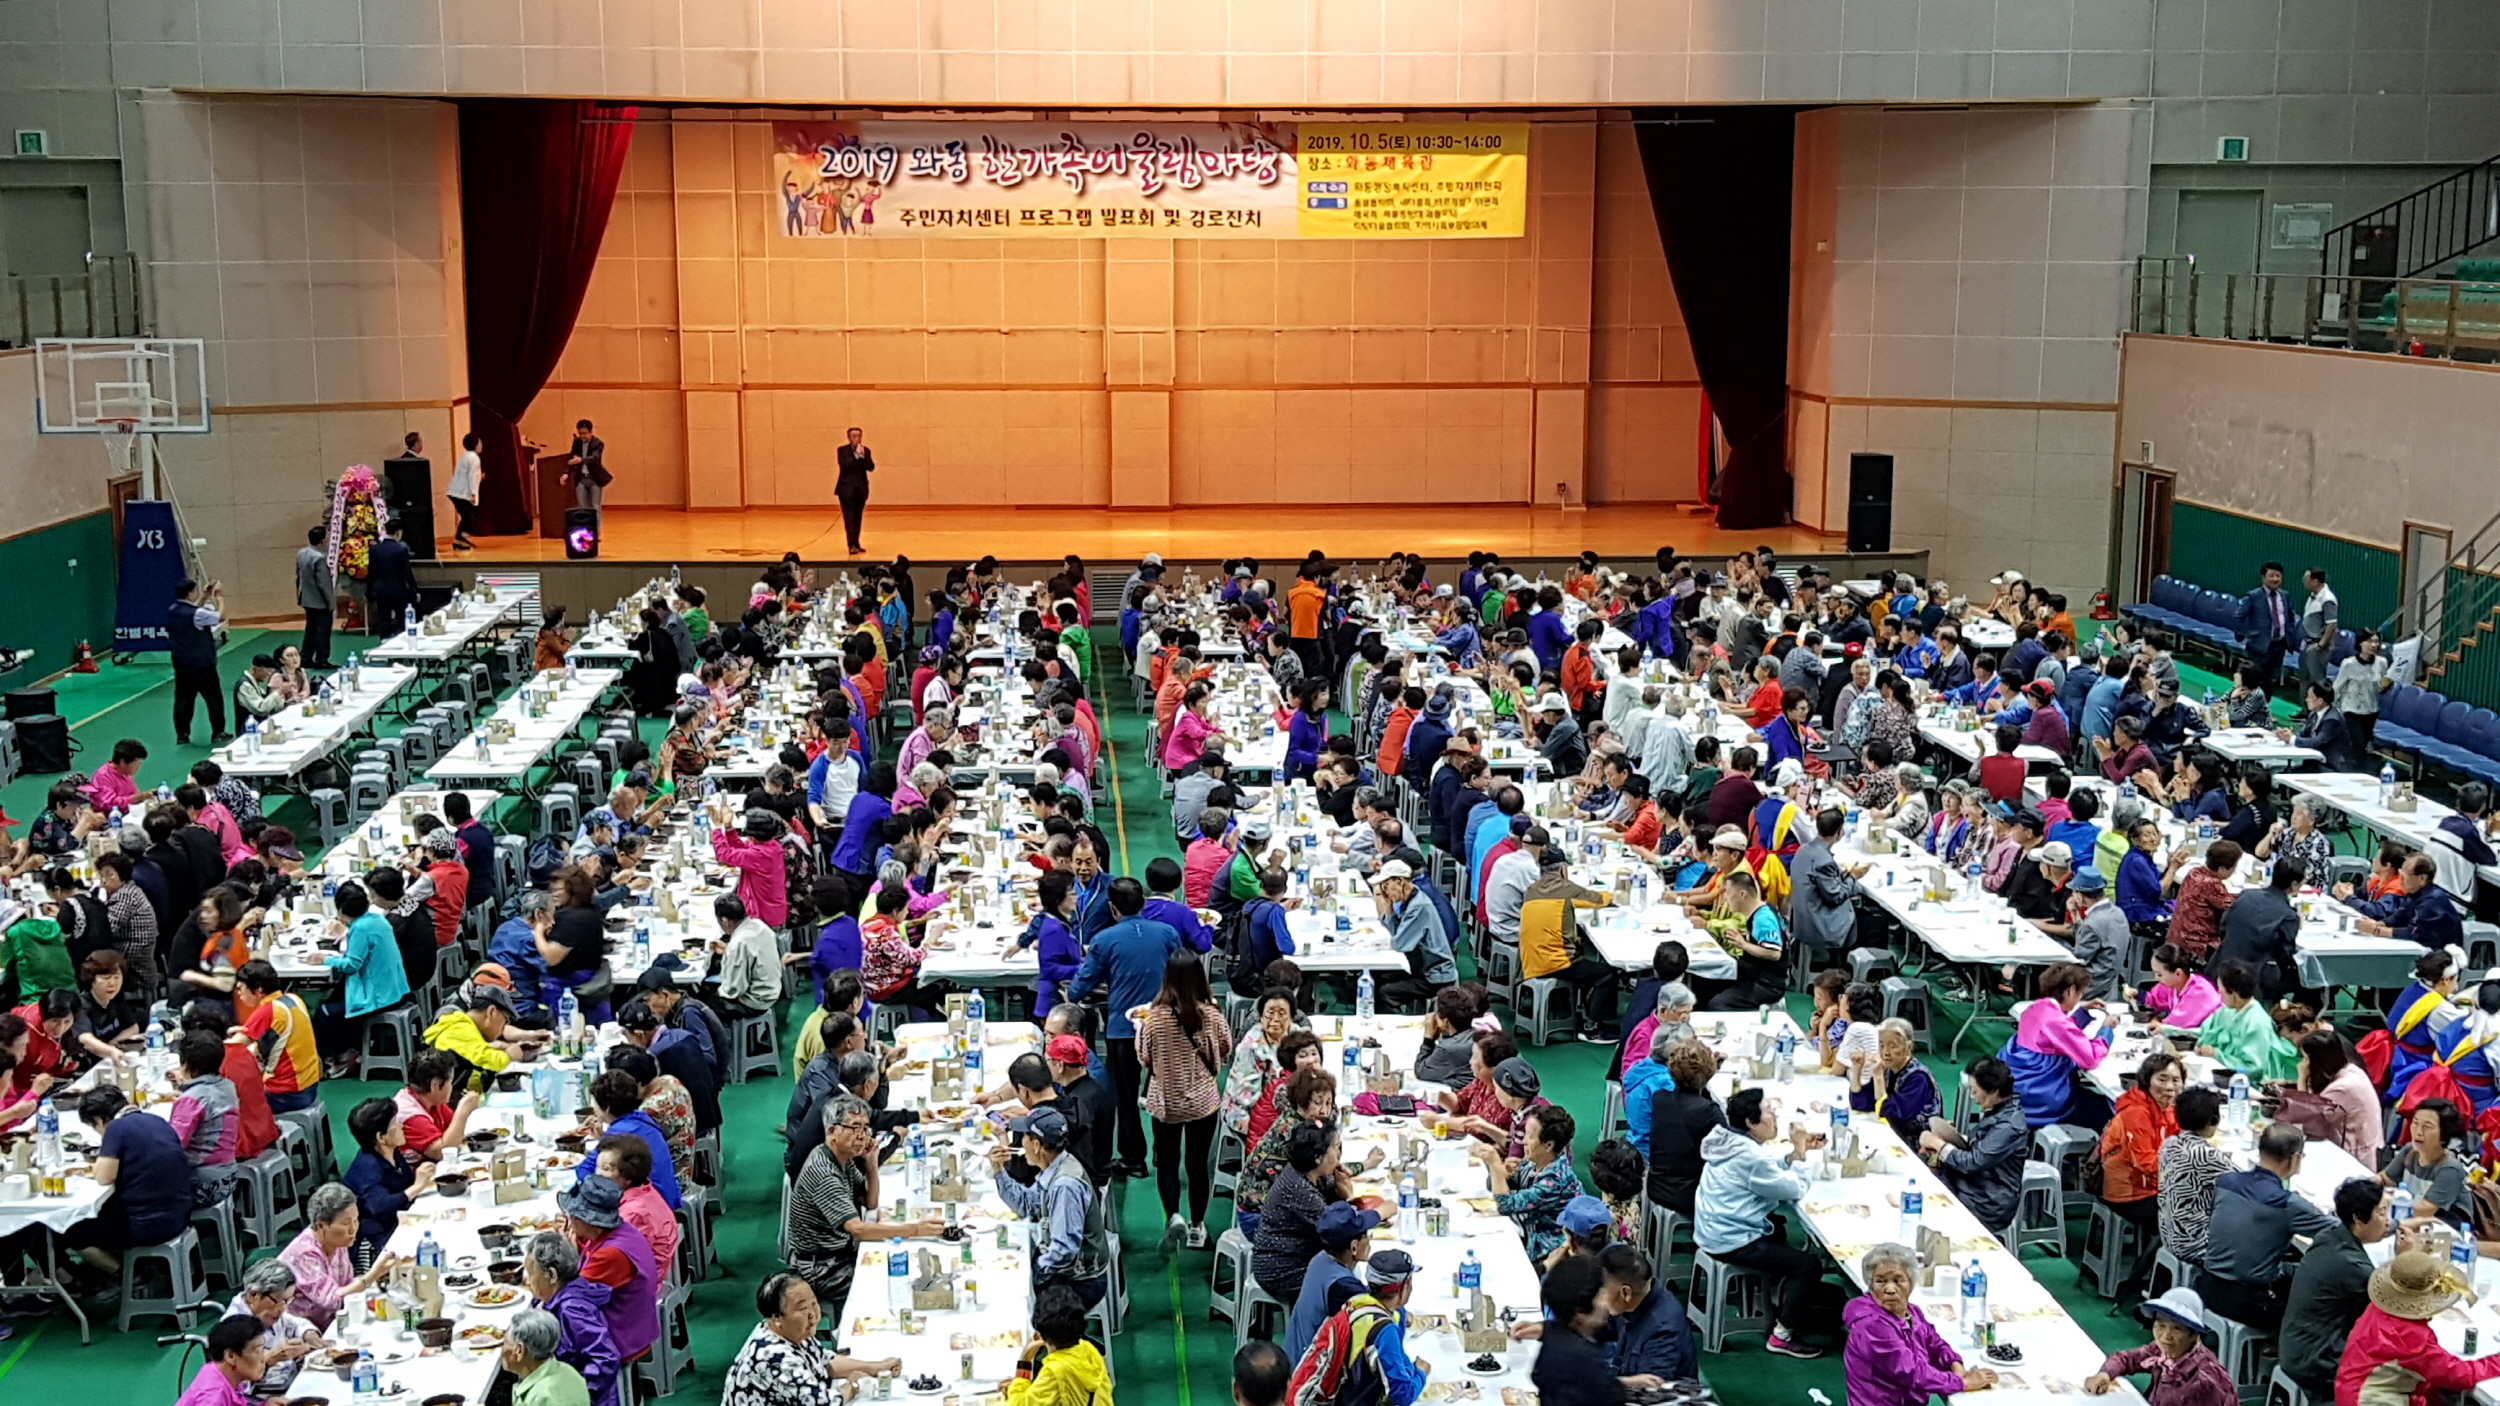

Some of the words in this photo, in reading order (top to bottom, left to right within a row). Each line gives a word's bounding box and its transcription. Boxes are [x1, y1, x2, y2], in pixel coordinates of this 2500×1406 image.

[1416, 135, 1502, 149] 10:30~14:00
[818, 144, 899, 183] 2019
[909, 141, 964, 181] 와동
[900, 208, 1010, 227] 주민자치센터
[1018, 208, 1093, 228] 프로그램
[1100, 208, 1155, 227] 발표회
[1163, 209, 1182, 228] 및
[1189, 208, 1262, 228] 경로잔치
